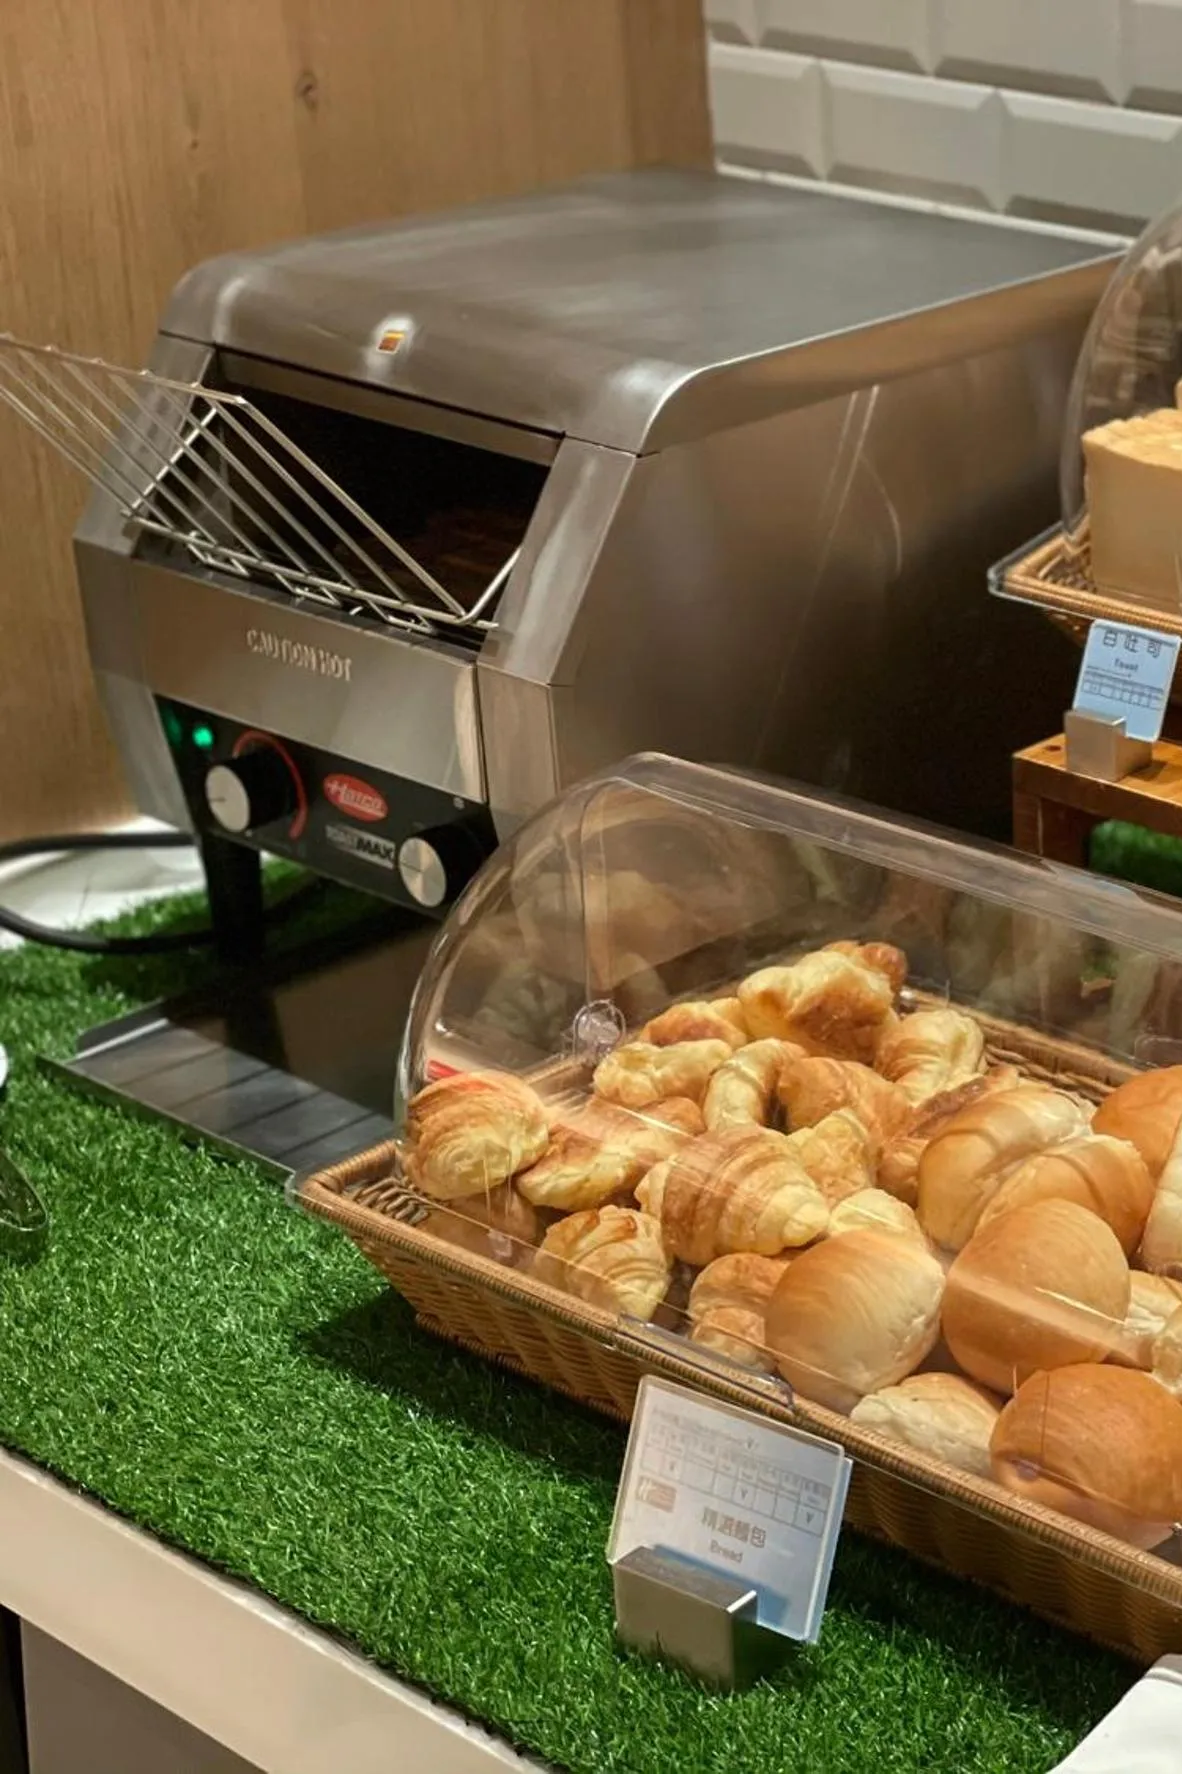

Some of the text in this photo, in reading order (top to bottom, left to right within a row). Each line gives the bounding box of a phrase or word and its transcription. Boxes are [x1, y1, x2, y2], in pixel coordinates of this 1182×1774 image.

[246, 629, 317, 672] CAUTION
[1102, 629, 1162, 659] 白吐司
